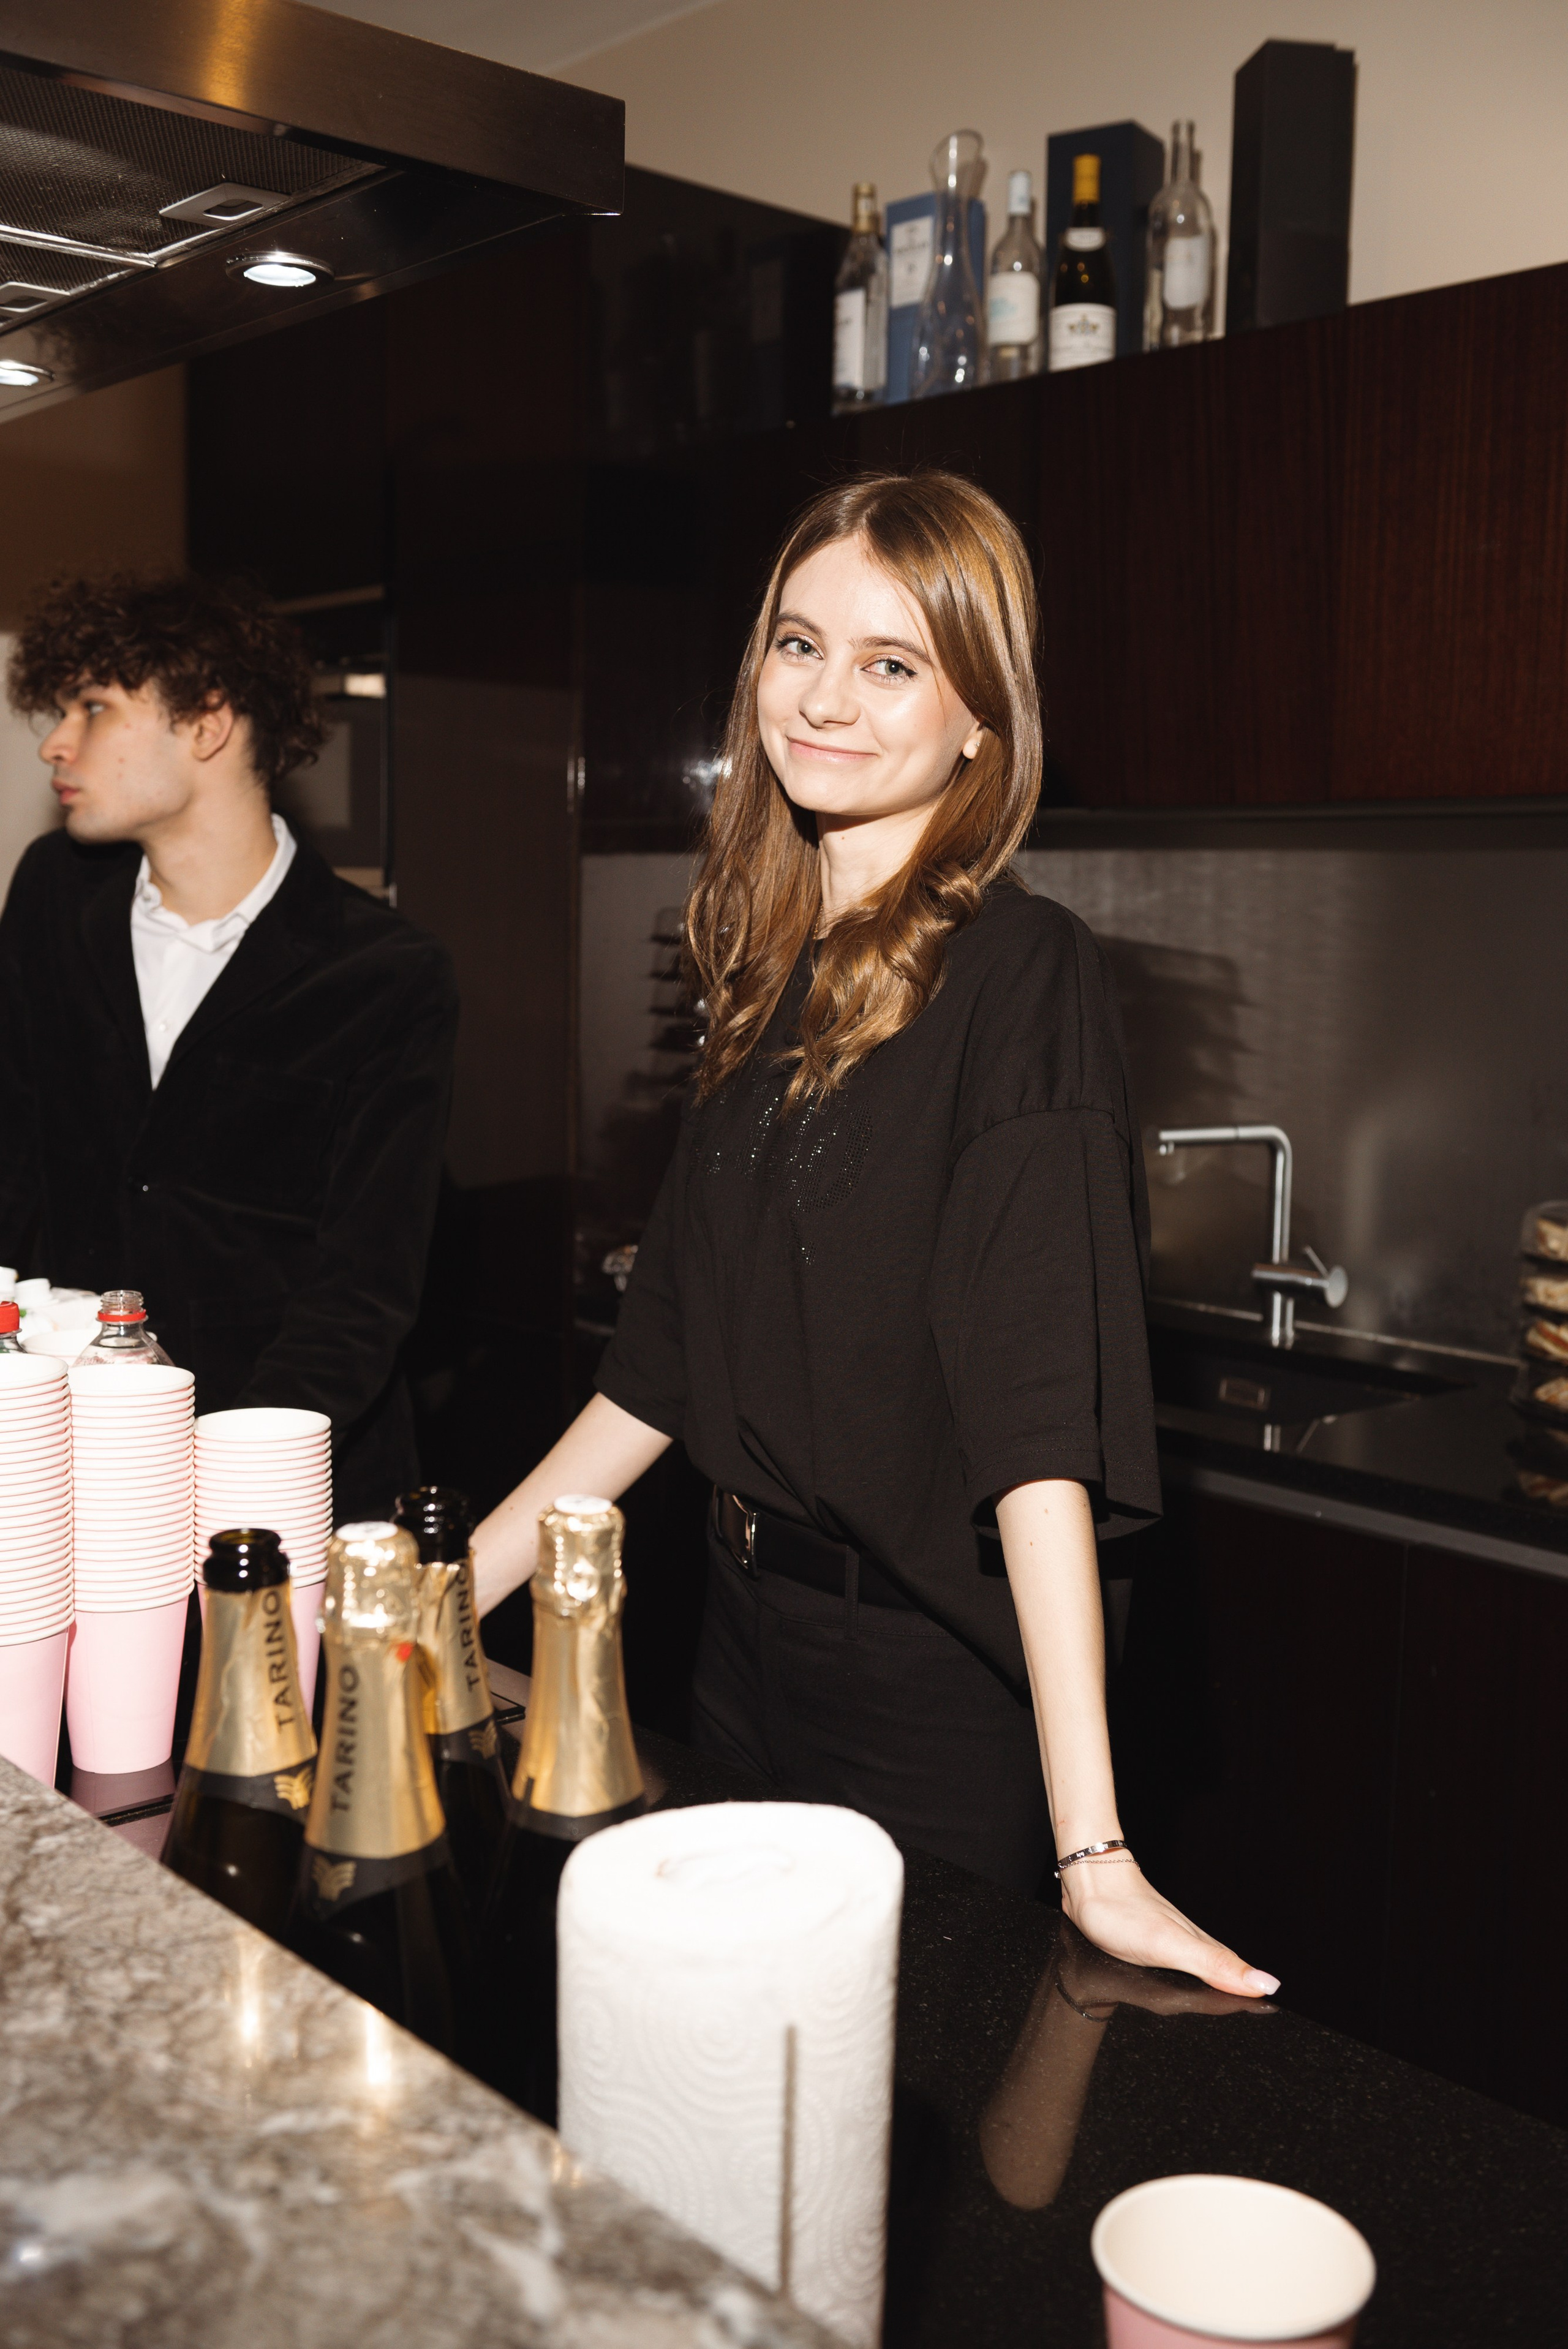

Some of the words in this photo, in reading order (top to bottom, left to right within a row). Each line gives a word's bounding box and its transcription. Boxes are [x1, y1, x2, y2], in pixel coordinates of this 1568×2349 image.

[262, 1591, 295, 1735] TARINO
[457, 1562, 480, 1692] TARINO
[330, 1664, 360, 1814] TARINO
